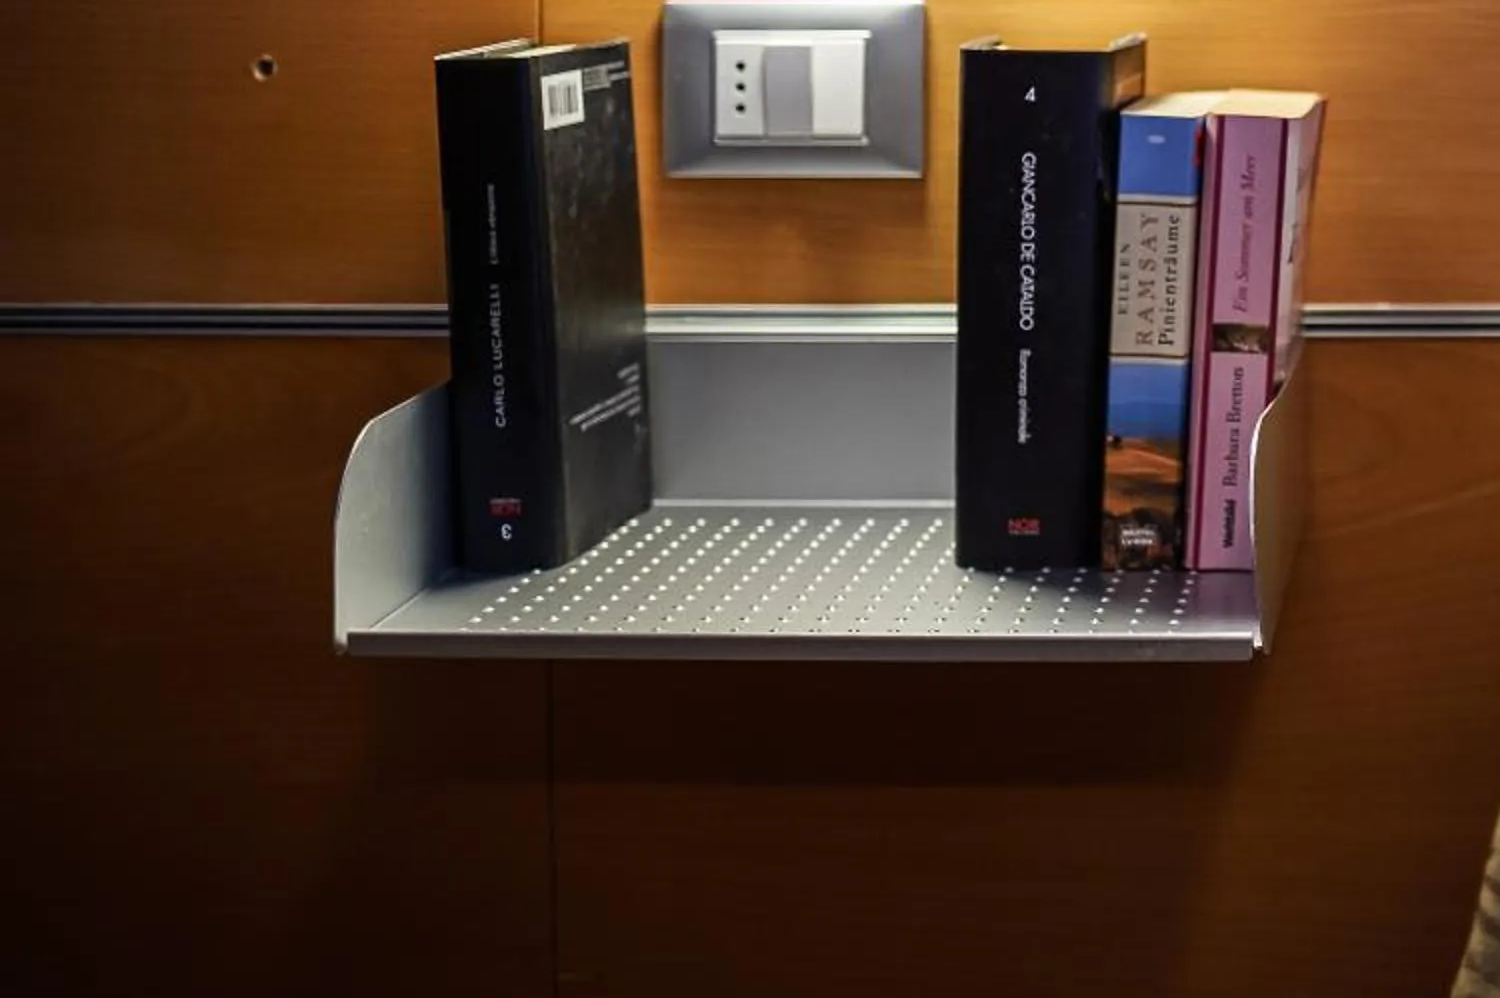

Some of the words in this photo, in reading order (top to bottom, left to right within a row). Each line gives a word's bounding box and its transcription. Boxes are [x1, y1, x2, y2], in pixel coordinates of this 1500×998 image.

[1025, 86, 1036, 103] 4
[1021, 151, 1037, 240] GIANCARLO
[1020, 242, 1035, 262] DE
[1118, 242, 1131, 315] EILEEN
[1135, 212, 1159, 346] RAMSAY
[1158, 214, 1180, 347] Pinienträume
[489, 283, 503, 370] LUCARELLI
[1020, 264, 1035, 331] CATALDO
[493, 374, 507, 428] CARLO
[1223, 427, 1240, 488] Barbara
[501, 523, 512, 541] 3
